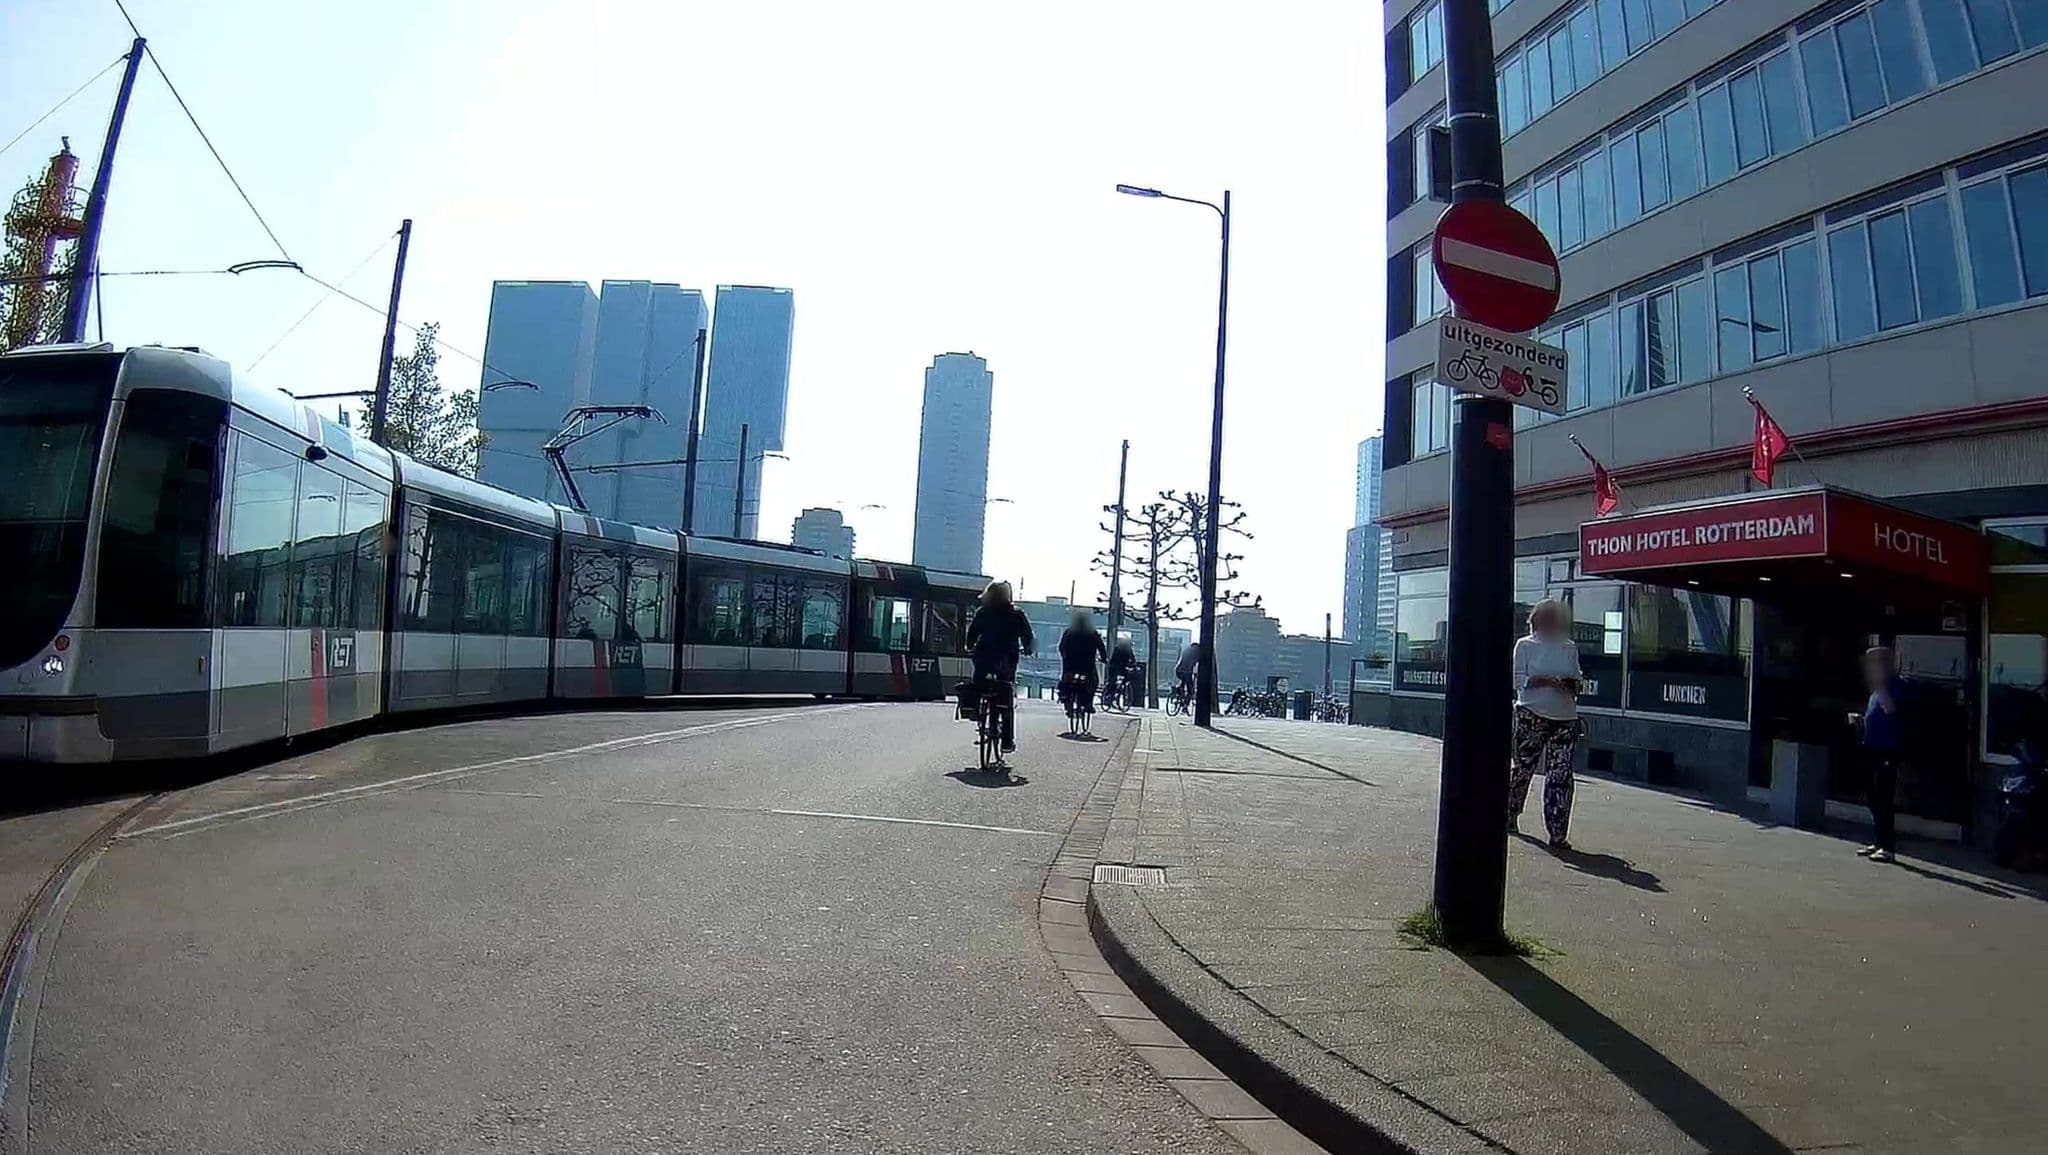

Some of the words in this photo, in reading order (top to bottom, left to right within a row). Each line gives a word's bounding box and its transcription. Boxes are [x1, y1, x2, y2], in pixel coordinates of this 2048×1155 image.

[1444, 325, 1565, 370] uitgezonderd
[1587, 535, 1632, 557] THON
[1636, 528, 1692, 552] HOTEL
[1695, 513, 1815, 545] ROTTERDAM
[1873, 521, 1949, 564] HOTEL
[911, 657, 936, 672] RET
